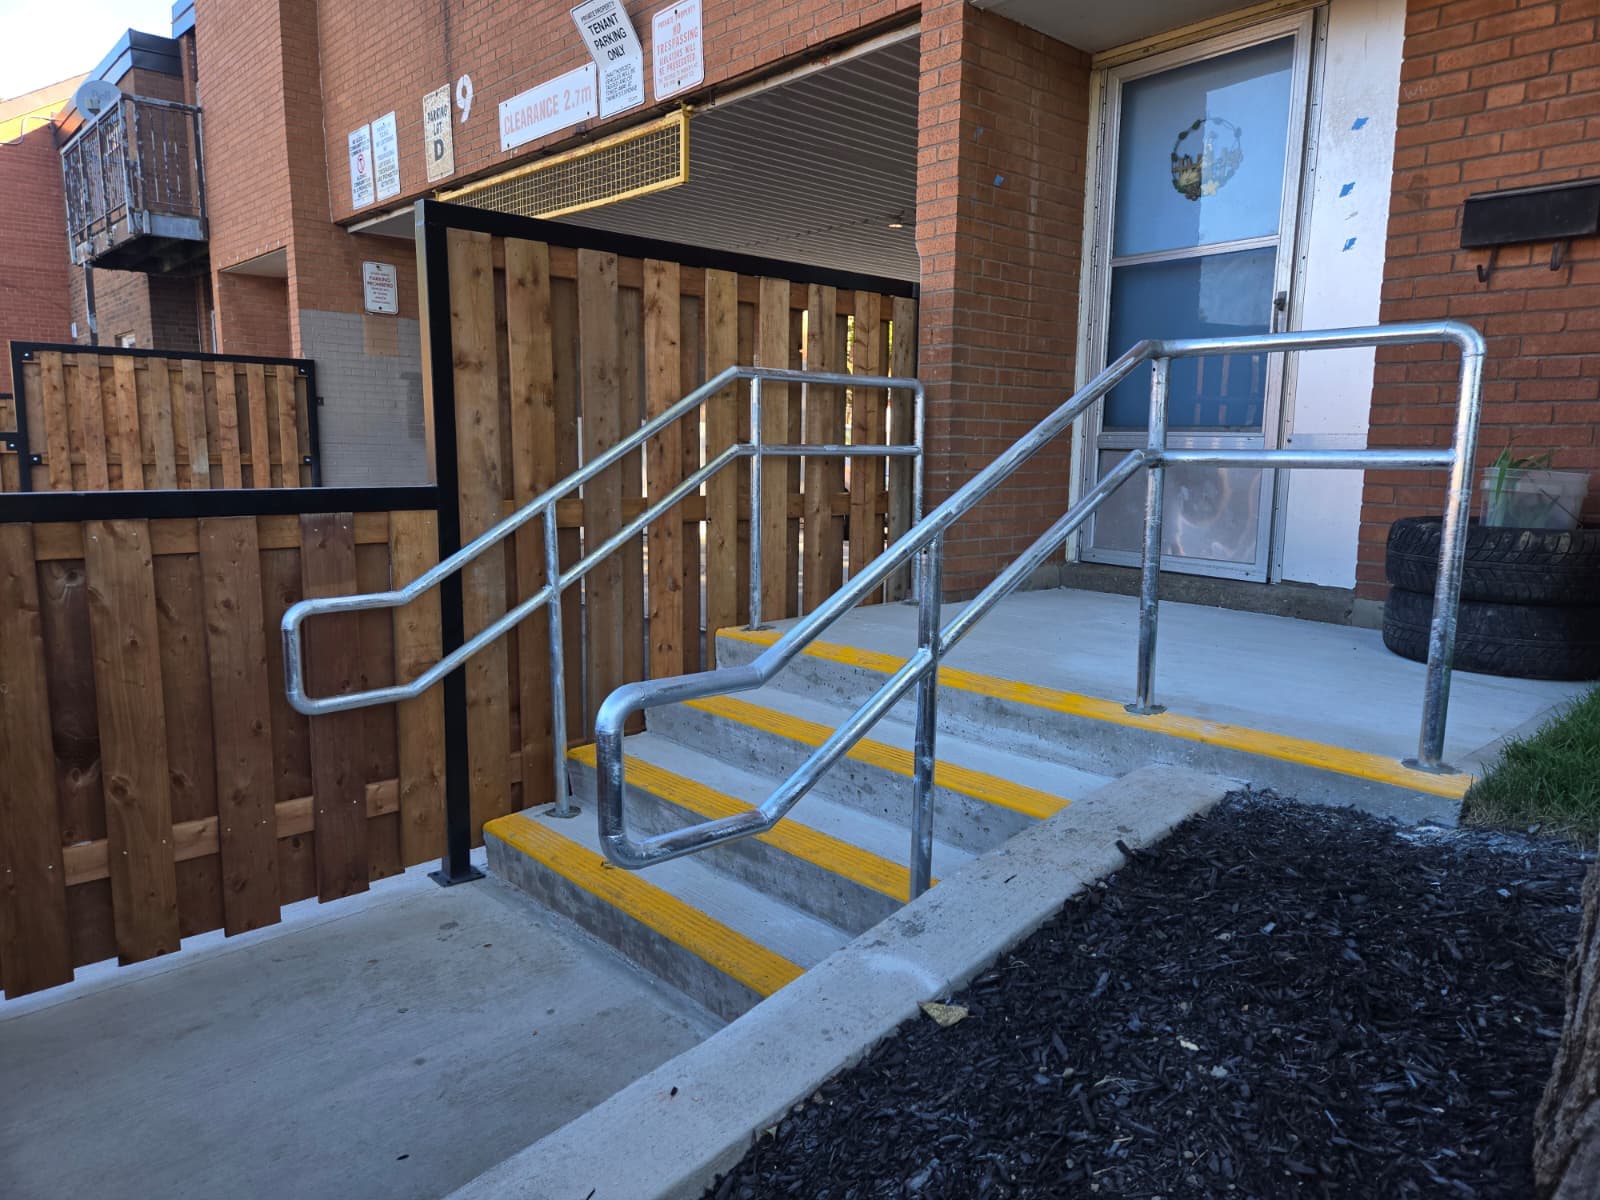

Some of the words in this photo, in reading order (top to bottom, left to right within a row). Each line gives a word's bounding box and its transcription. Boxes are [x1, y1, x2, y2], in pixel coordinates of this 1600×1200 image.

[587, 12, 619, 36] TENANT
[672, 22, 682, 35] NO
[593, 27, 627, 50] PARKING
[656, 26, 699, 56] TRESPASSING
[607, 44, 626, 61] ONLY
[659, 49, 683, 66] VIOLATORS
[685, 42, 696, 54] WILL
[659, 65, 665, 76] BE
[666, 53, 696, 73] PROSECUTED
[456, 74, 473, 123] 9
[427, 104, 448, 125] PARKING
[504, 94, 559, 136] CLEARANCE
[563, 85, 592, 111] 2.7m
[433, 121, 442, 136] LOT
[433, 138, 444, 161] D
